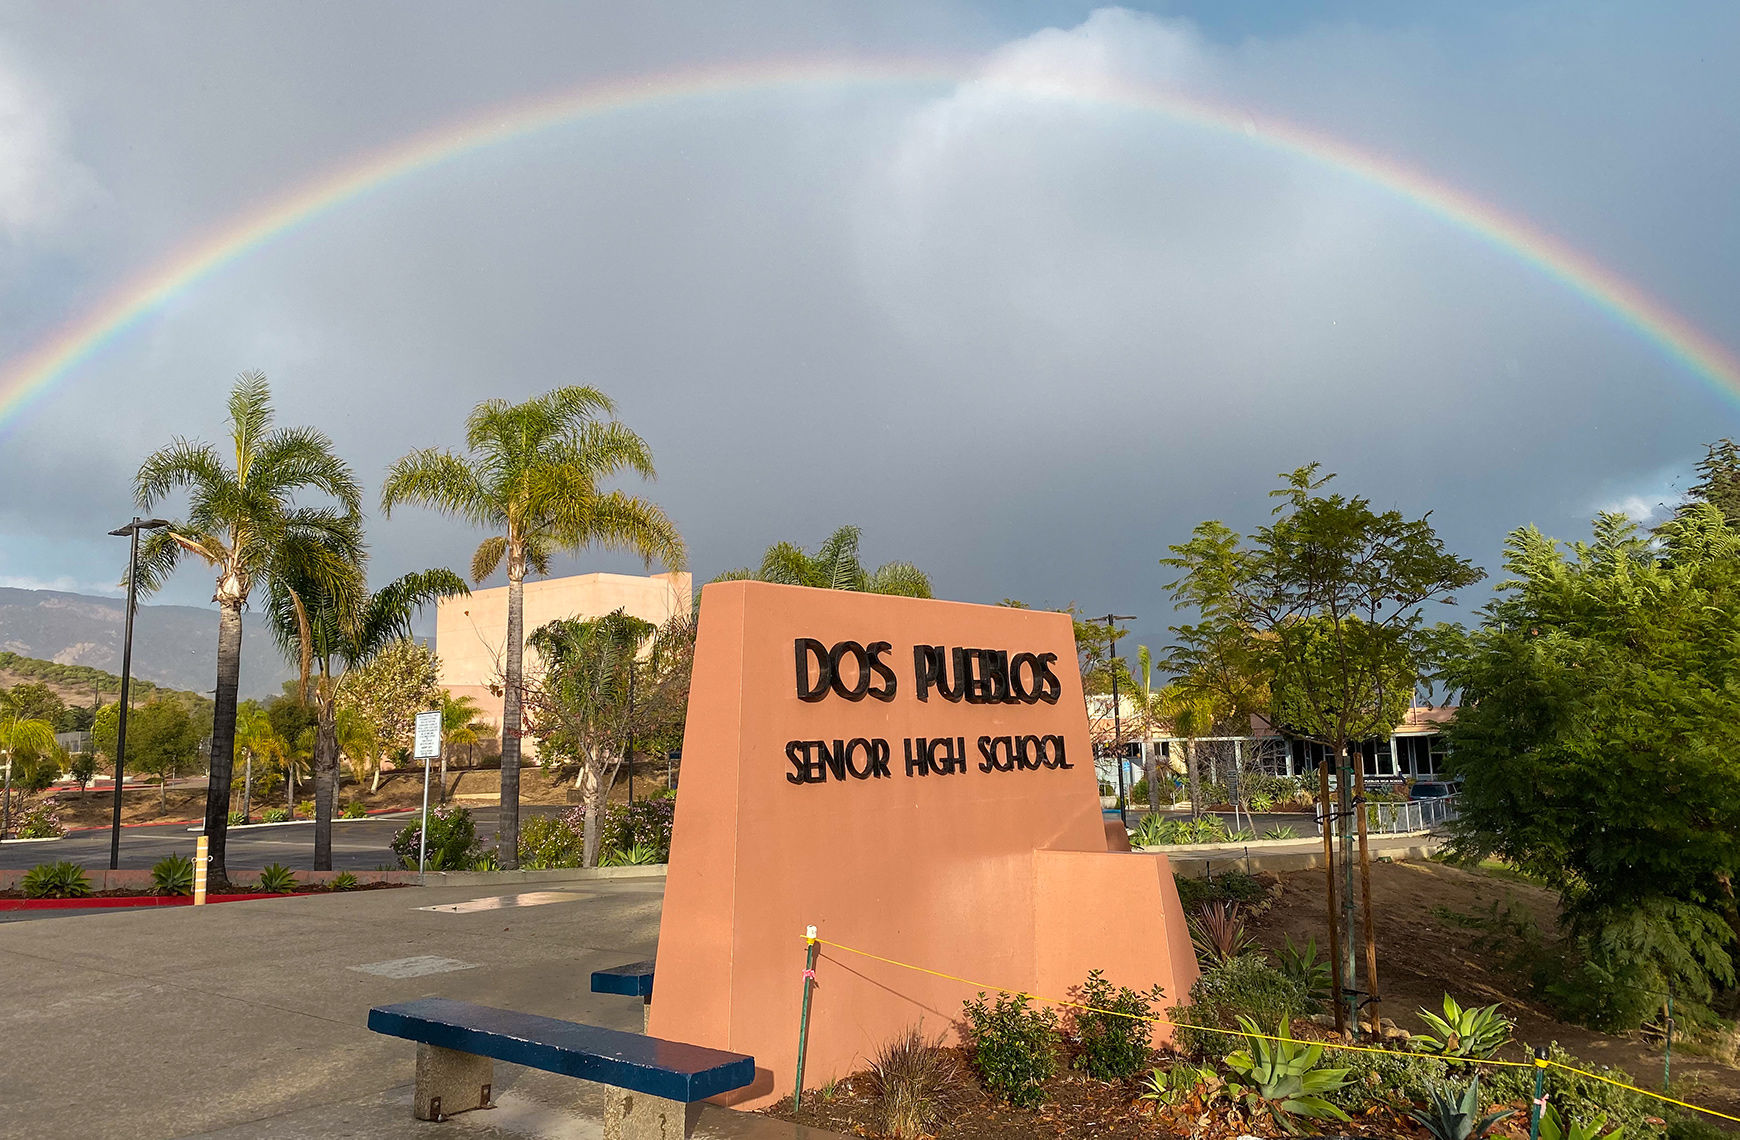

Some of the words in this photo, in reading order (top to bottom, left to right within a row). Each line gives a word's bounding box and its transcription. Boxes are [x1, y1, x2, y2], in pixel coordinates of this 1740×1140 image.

[794, 637, 897, 702] DOS
[913, 644, 1061, 705] PUEBLOS
[785, 738, 892, 785] SENIOR
[903, 736, 967, 777] HIGH
[977, 735, 1074, 773] SCHOOL
